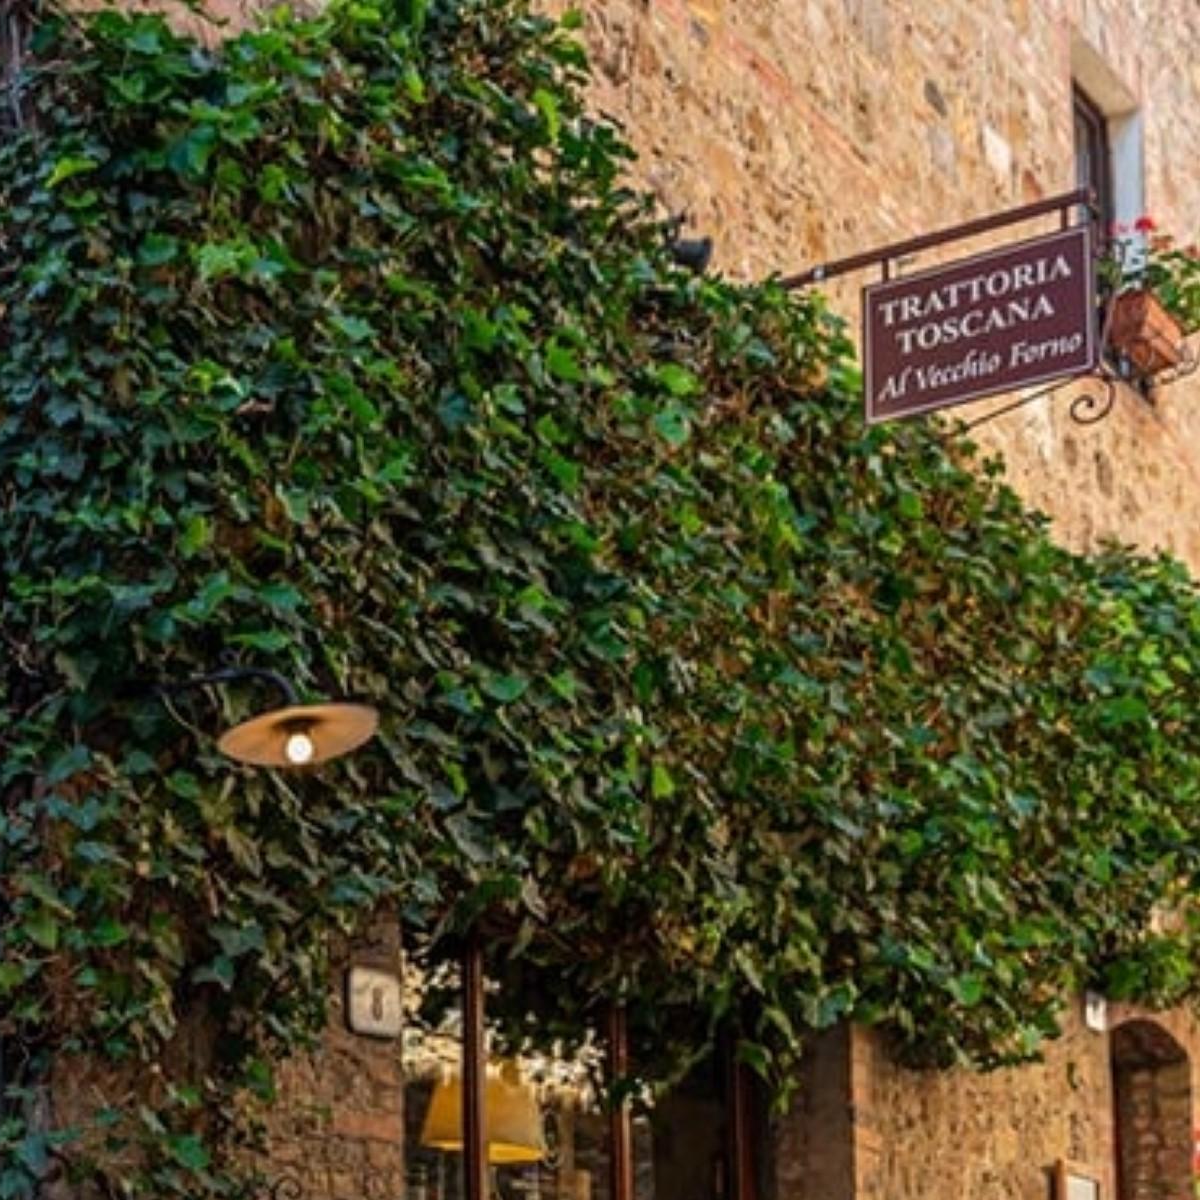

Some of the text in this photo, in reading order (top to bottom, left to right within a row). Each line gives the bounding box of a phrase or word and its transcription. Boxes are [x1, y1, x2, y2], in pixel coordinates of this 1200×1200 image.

[878, 255, 1072, 327] TRATTORIA
[895, 295, 1055, 354] TOSCANA
[916, 349, 1001, 390] Vecchio
[1008, 332, 1083, 368] Forno
